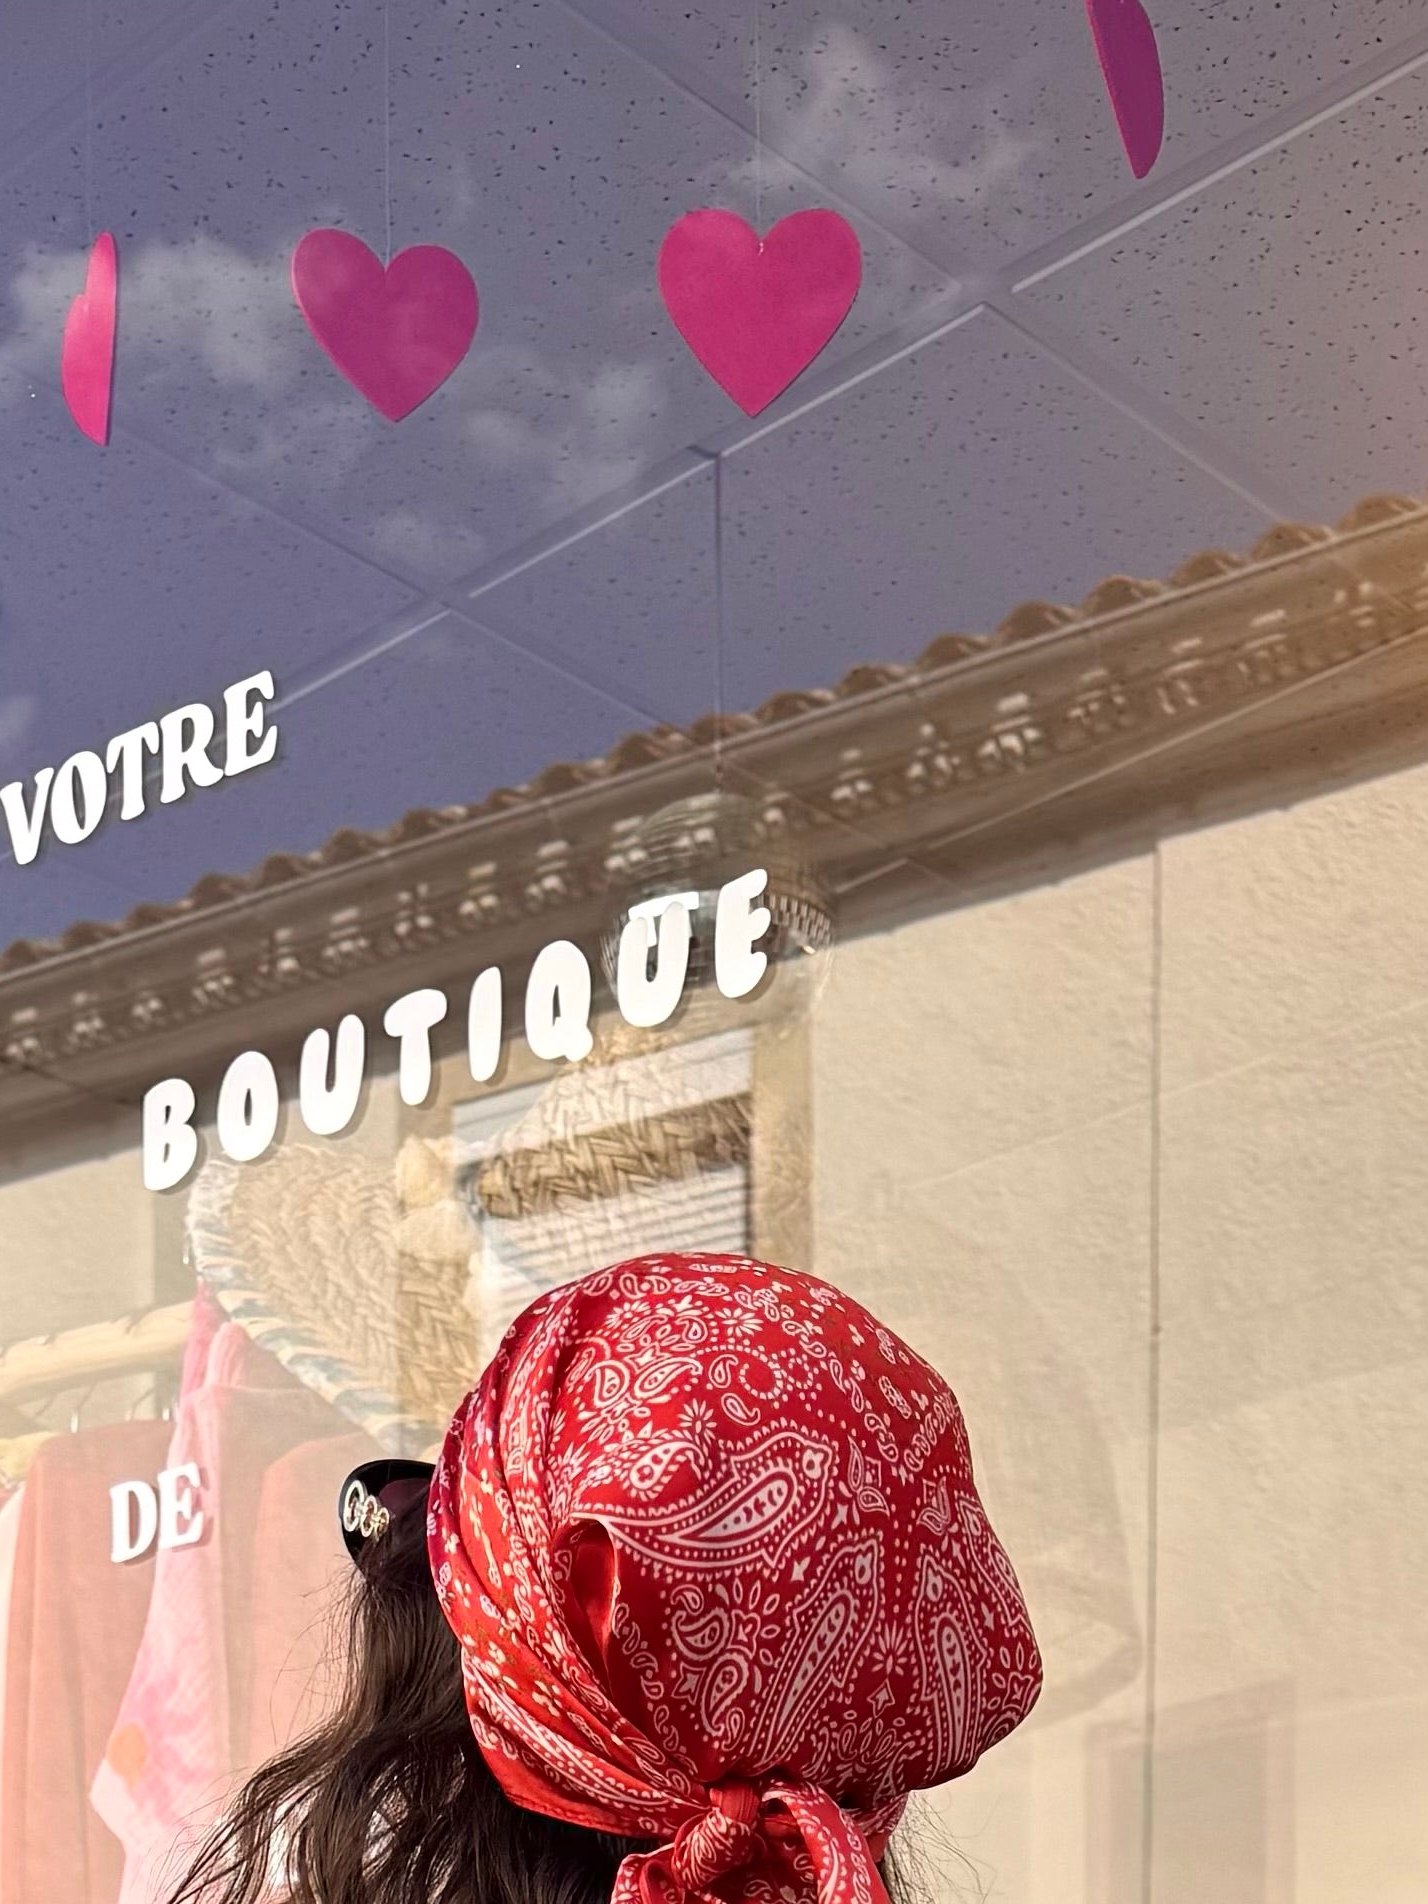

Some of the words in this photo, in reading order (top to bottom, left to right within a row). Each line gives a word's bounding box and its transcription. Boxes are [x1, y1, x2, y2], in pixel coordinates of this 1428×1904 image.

[0, 671, 278, 864] VOTRE
[142, 868, 770, 1191] BOUTIQUE
[110, 1464, 205, 1564] DE
